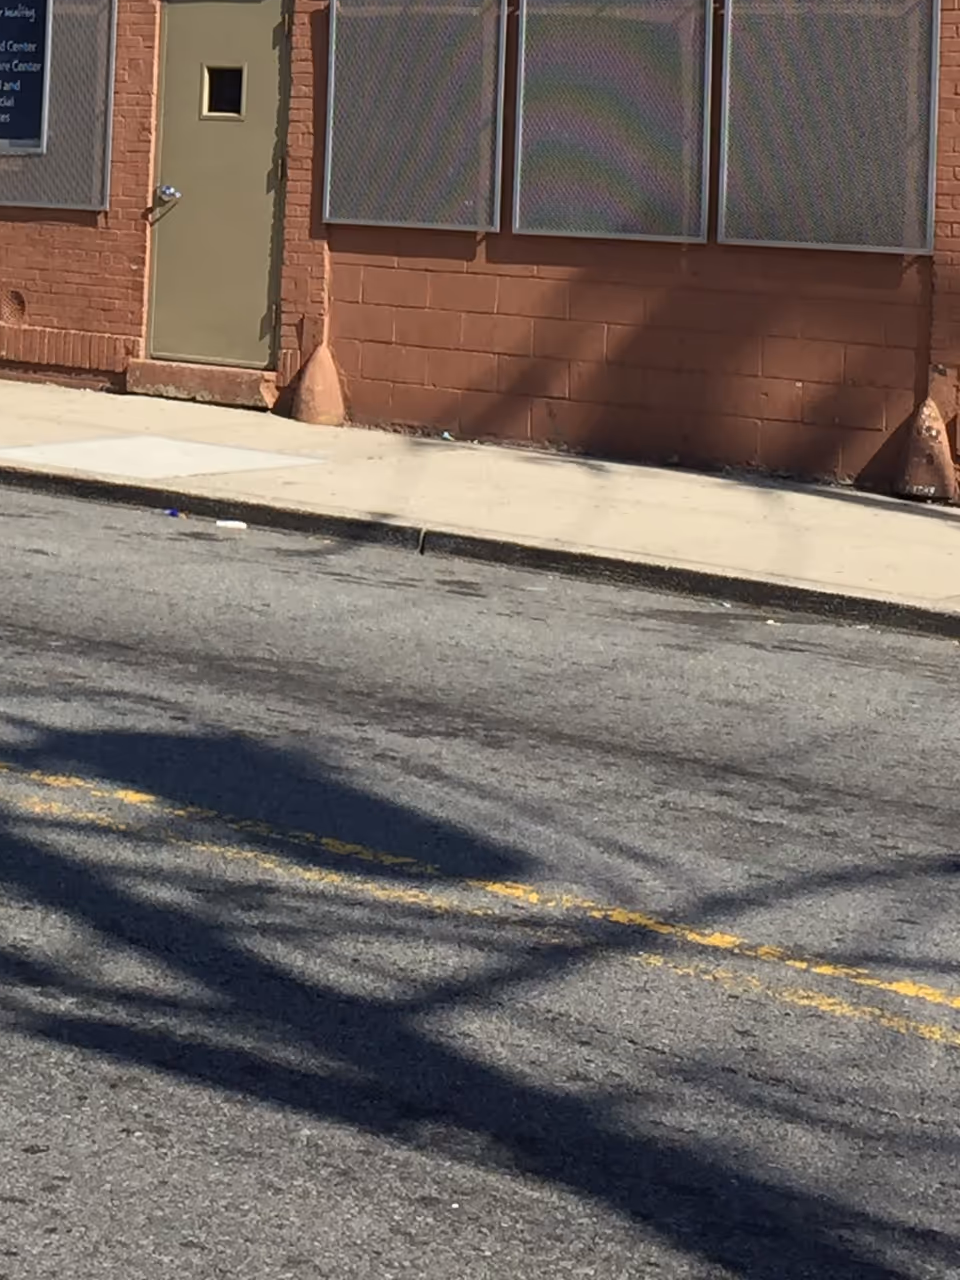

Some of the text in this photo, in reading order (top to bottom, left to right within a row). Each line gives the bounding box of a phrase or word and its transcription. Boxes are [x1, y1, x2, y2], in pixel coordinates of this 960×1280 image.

[7, 41, 38, 51] Center
[11, 61, 41, 71] Center
[3, 80, 20, 90] and
